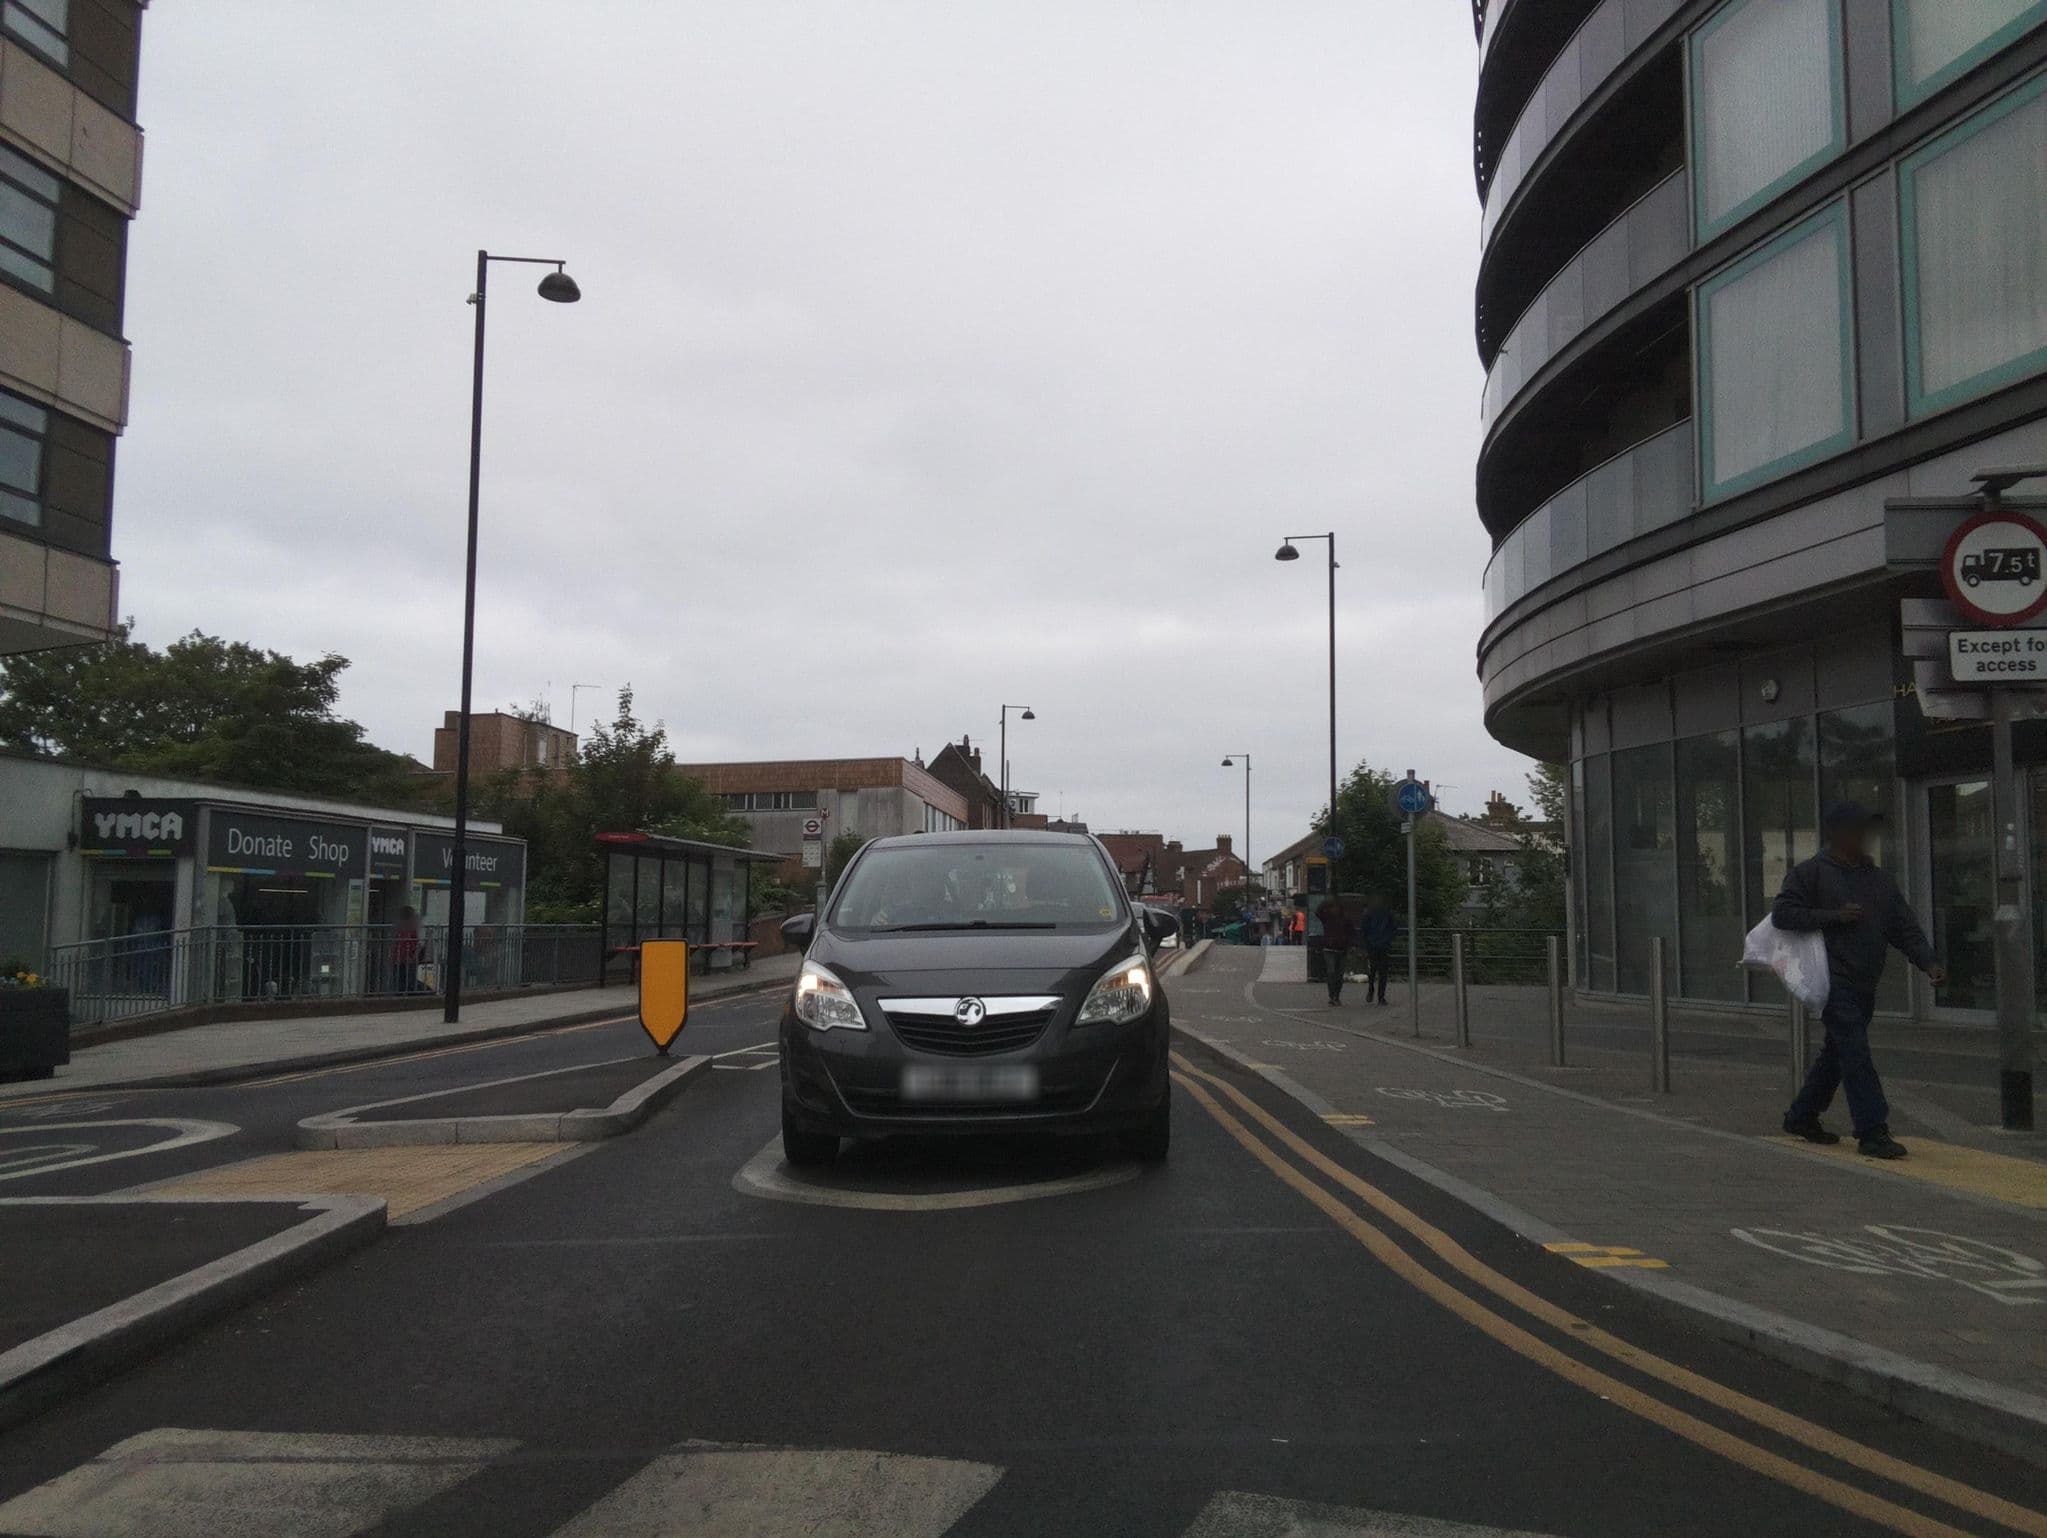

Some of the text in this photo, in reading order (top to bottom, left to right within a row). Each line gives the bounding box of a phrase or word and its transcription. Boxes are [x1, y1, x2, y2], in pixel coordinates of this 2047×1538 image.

[1957, 637, 2047, 656] Except fo
[1976, 658, 2037, 673] access
[94, 811, 183, 841] YMCA
[228, 827, 349, 867] Donate Shop
[371, 836, 405, 856] YMCA
